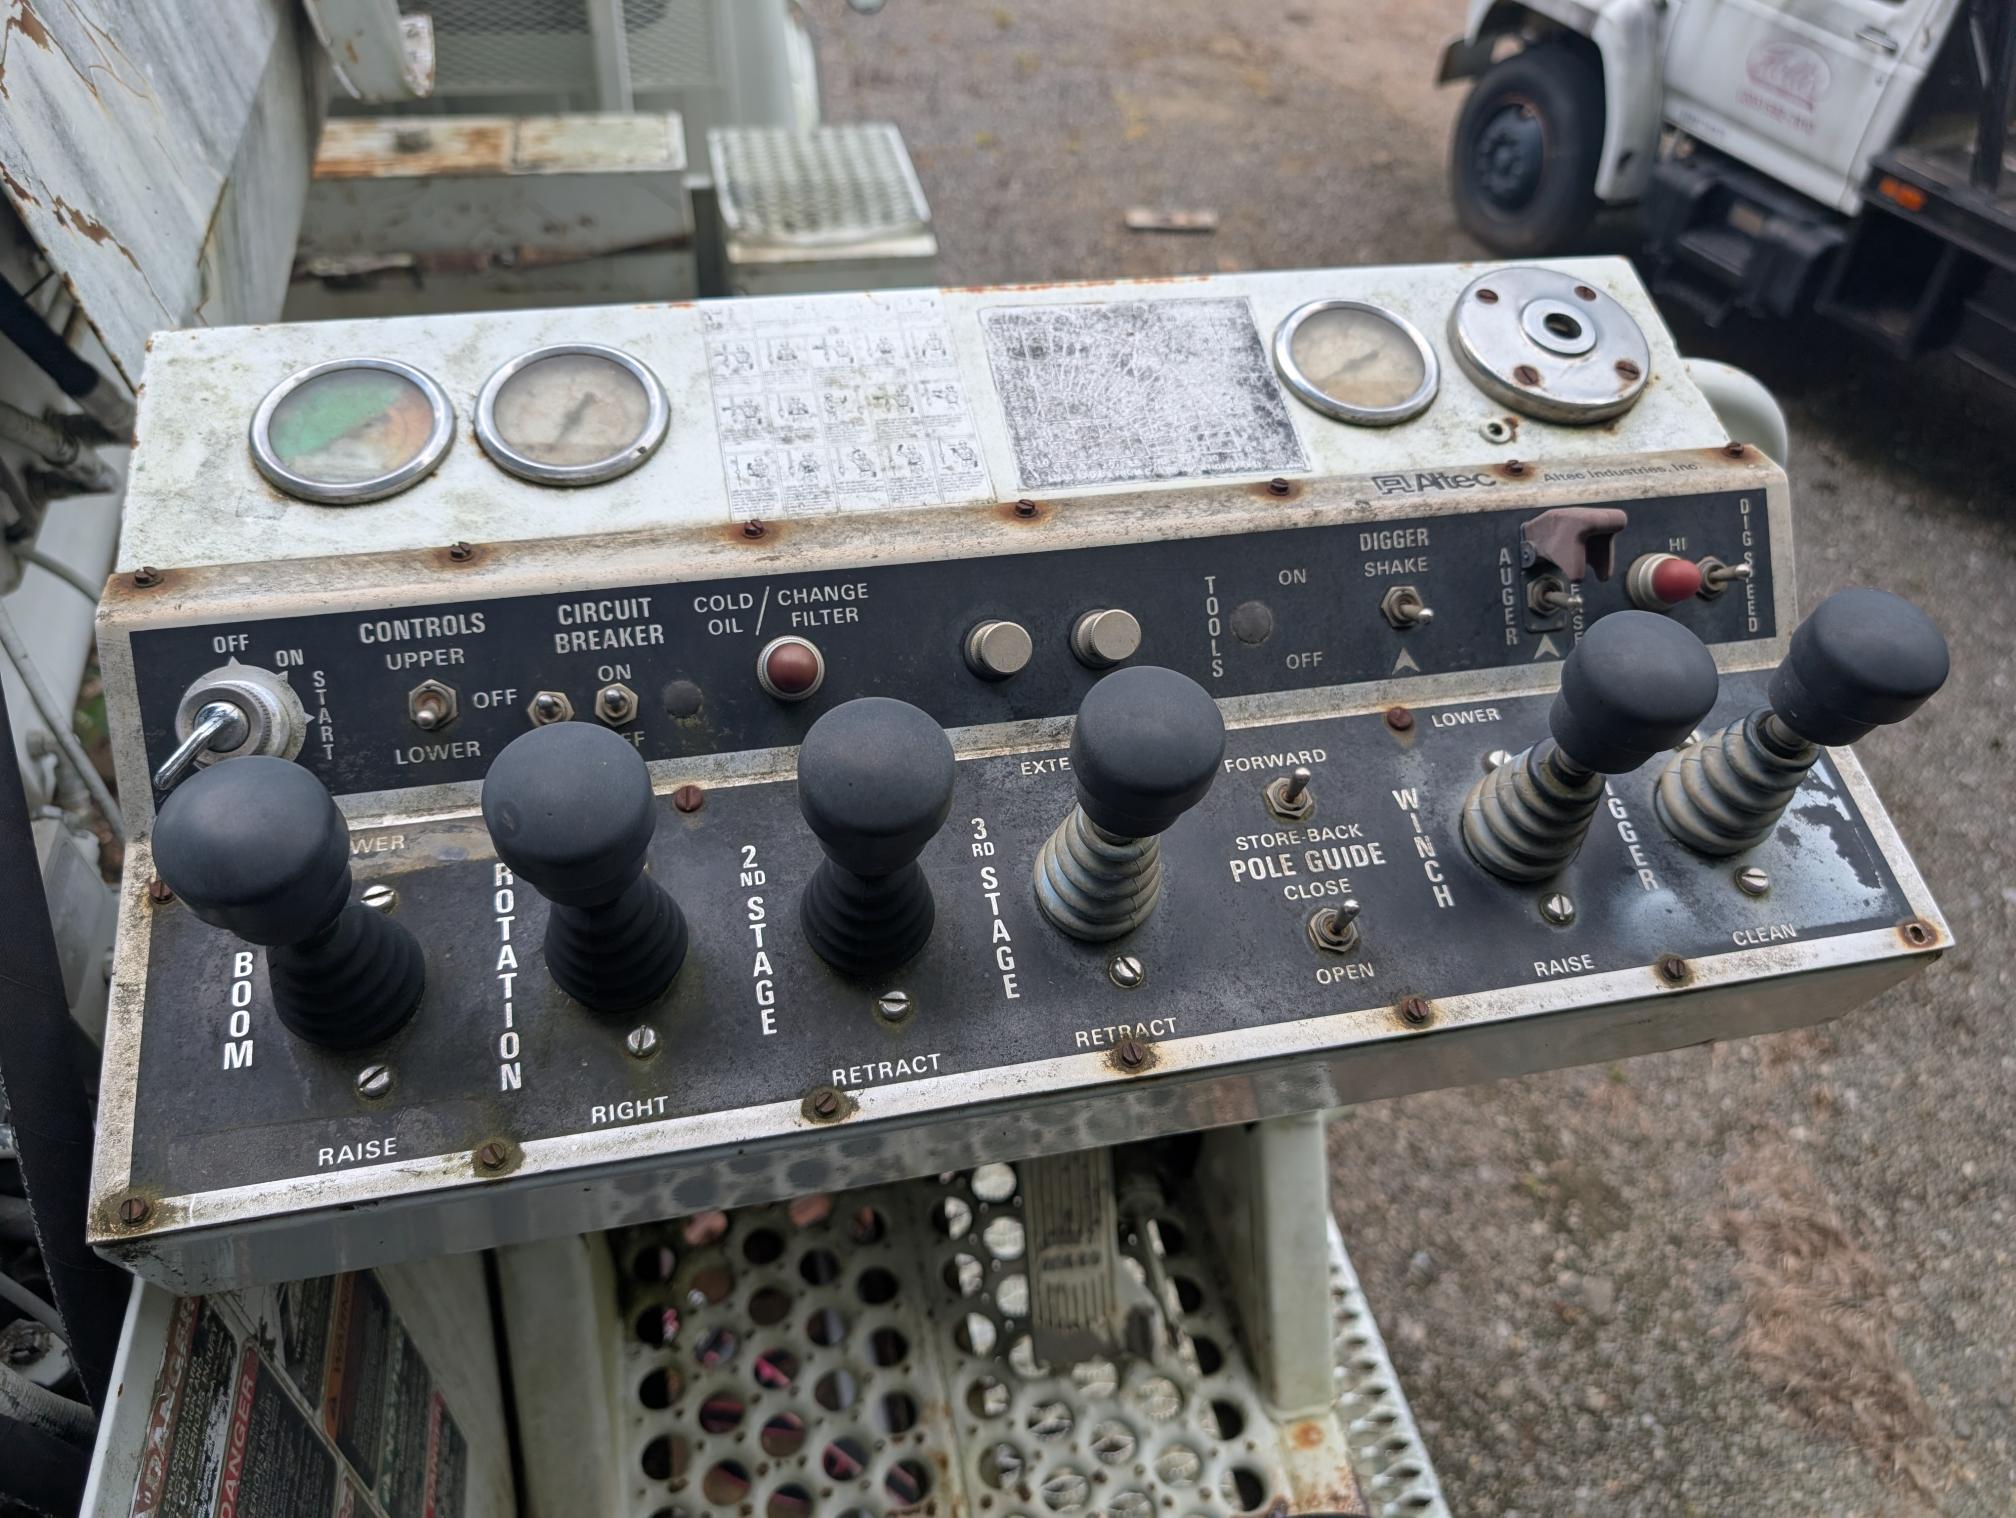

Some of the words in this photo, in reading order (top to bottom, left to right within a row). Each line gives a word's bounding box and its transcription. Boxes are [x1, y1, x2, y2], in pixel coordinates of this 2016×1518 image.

[1414, 472, 1497, 492] Altec
[1544, 472, 1585, 482] Altec
[1672, 463, 1703, 472] Inc.
[1740, 498, 1752, 546] DIG
[1359, 528, 1430, 553] DIGGER
[1669, 538, 1686, 551] HI
[1278, 569, 1307, 586] ON
[1364, 557, 1429, 577] SHAKE
[693, 592, 754, 614] COLD
[777, 582, 869, 606] CHANGE
[1499, 547, 1518, 645] AUGER
[557, 598, 653, 626] CIRCUIT
[708, 616, 744, 637] OIL
[791, 607, 860, 629] FILTER
[359, 612, 486, 644] CONTROLS
[554, 624, 665, 655] BREAKER
[1205, 576, 1224, 679] TOOLS
[213, 635, 249, 655] OFF
[275, 649, 304, 668] ON
[385, 648, 465, 672] UPPER
[598, 664, 631, 681] ON
[1286, 651, 1324, 670] OFF
[473, 689, 518, 710] OFF
[312, 670, 334, 761] START
[1431, 707, 1501, 729] LOWER
[395, 740, 481, 765] LOWER
[1021, 757, 1071, 776] EXTE
[1224, 747, 1327, 773] FORWARD
[350, 835, 405, 855] WER
[1392, 788, 1454, 909] WINCH
[1605, 781, 1659, 891] IGGER
[1229, 851, 1299, 883] POLE
[1305, 842, 1387, 874] GUIDE
[1284, 878, 1352, 901] CLOSE
[980, 866, 1021, 1000] STAGE
[1731, 924, 1797, 947] CLEAN
[493, 862, 523, 1092] ROTATION
[747, 896, 778, 1036] STAGE
[1315, 962, 1375, 986] OPEN
[1533, 954, 1596, 978] RAISE
[223, 951, 254, 1071] BOOM
[1075, 1017, 1178, 1048] RETRACT
[832, 1053, 942, 1087] RETRACT
[591, 1096, 668, 1125] RIGHT
[318, 1137, 398, 1167] RAISE
[220, 1374, 254, 1518] DANGER
[179, 1476, 190, 1506] OR
[250, 1453, 264, 1516] ERIOUS
